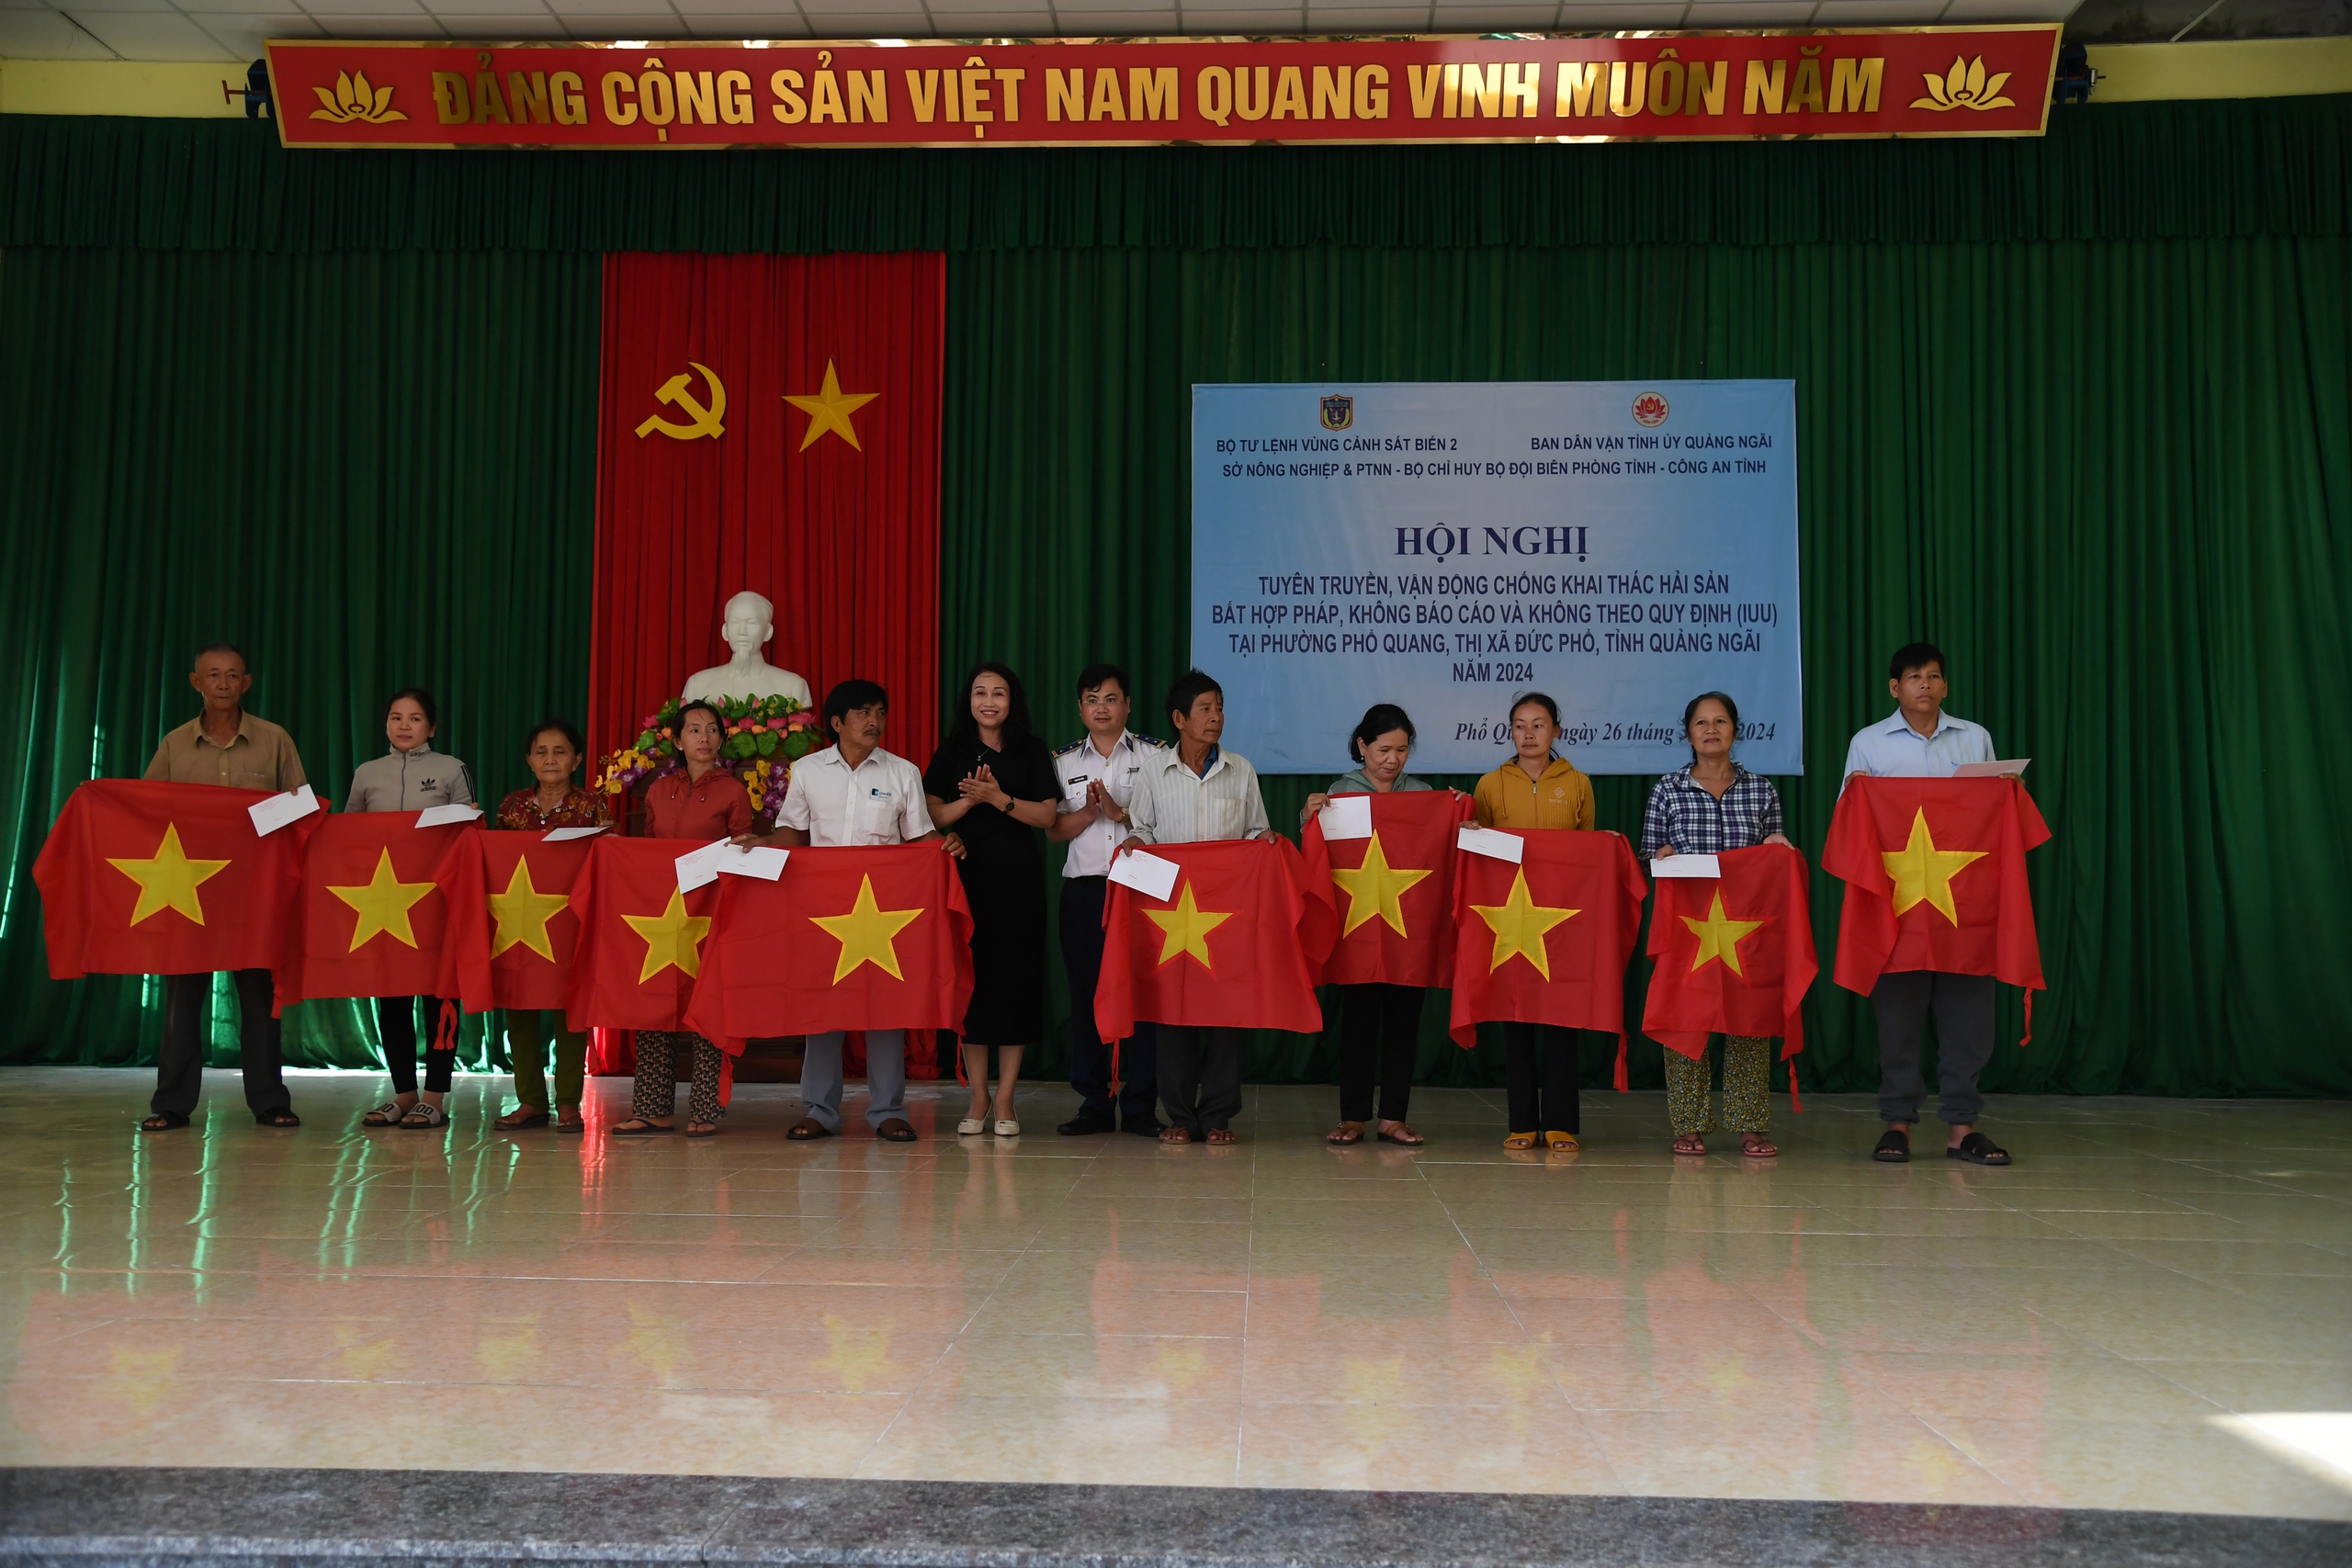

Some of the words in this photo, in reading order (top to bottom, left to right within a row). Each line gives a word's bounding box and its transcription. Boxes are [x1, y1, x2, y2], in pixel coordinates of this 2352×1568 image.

[432, 51, 588, 126] ĐẢNG
[602, 58, 753, 141] CỘNG
[771, 51, 888, 124] SẢN
[905, 57, 1025, 139] VIỆT
[1046, 67, 1179, 121] NAM
[1197, 64, 1389, 127] QUANG
[1407, 62, 1541, 119] VINH
[1555, 48, 1728, 118] MUÔN
[1742, 45, 1885, 115] NĂM
[1216, 439, 1236, 455] BỘ
[1239, 440, 1259, 452] TƯ
[1262, 438, 1297, 455] LỆNH
[1301, 436, 1339, 452] VÙNG
[1343, 436, 1381, 451] CẢNH
[1385, 436, 1411, 451] SÁT
[1415, 435, 1446, 451] BIỂN
[1450, 438, 1458, 451] 2
[1531, 437, 1559, 450] BAN
[1564, 434, 1592, 450] DÂN
[1596, 435, 1623, 453] VẬN
[1628, 434, 1658, 449] TỈNH
[1663, 434, 1680, 449] ỦY
[1685, 433, 1735, 449] QUẢNG
[1738, 434, 1771, 448] NGÃI
[1223, 461, 1243, 477] SỞ
[1247, 461, 1285, 477] NÔNG
[1289, 462, 1340, 479] NGHIỆP
[1343, 463, 1352, 476] &
[1357, 463, 1392, 476] PTNN
[1404, 462, 1424, 479] BỘ
[1428, 460, 1450, 476] CHỈ
[1454, 463, 1482, 476] HUY
[1486, 461, 1506, 479] BỘ
[1509, 461, 1532, 479] ĐỘI
[1537, 459, 1568, 475] BIÊN
[1572, 459, 1621, 475] PHÒNG
[1624, 458, 1656, 474] TỈNH
[1668, 458, 1708, 474] CÔNG
[1712, 461, 1731, 474] AN
[1735, 457, 1766, 473] TỈNH
[1394, 522, 1472, 563] HỘI
[1482, 526, 1589, 562] NGHỊ
[1259, 571, 1315, 595] TUYÊN
[1320, 571, 1393, 598] TRUYỀN,
[1397, 574, 1433, 599] VẬN
[1438, 573, 1488, 599] ĐỘNG
[1493, 571, 1556, 595] CHỐNG
[1562, 575, 1602, 594] KHAI
[1607, 570, 1654, 594] THÁC
[1659, 570, 1689, 593] HẢI
[1693, 570, 1729, 593] SẢN
[1212, 601, 1246, 625] BẤT
[1251, 604, 1288, 628] HỢP
[1293, 600, 1343, 627] PHÁP,
[1349, 600, 1411, 625] KHÔNG
[1417, 600, 1453, 624] BÁO
[1458, 600, 1495, 624] CÁO
[1499, 600, 1524, 624] VÀ
[1529, 600, 1591, 624] KHÔNG
[1597, 604, 1644, 624] THEO
[1648, 604, 1685, 624] QUY
[1690, 604, 1732, 627] ĐỊNH
[1736, 604, 1778, 627] (IUU)
[1229, 634, 1256, 658] TẠI
[1261, 628, 1337, 653] PHƯỜNG
[1342, 628, 1377, 653] PHỔ
[1383, 634, 1450, 656] QUANG,
[1454, 634, 1481, 657] THỊ
[1487, 629, 1510, 653] XÃ
[1515, 629, 1554, 652] ĐỨC
[1559, 628, 1600, 656] PHỔ,
[1604, 629, 1645, 653] TỈNH
[1649, 628, 1713, 653] QUẢNG
[1718, 629, 1760, 652] NGÃI
[1453, 659, 1490, 682] NĂM
[1496, 662, 1533, 682] 2024
[1453, 716, 1487, 740] Phổ
[1601, 722, 1623, 741] 26
[1626, 722, 1675, 746] tháng
[1736, 722, 1776, 741] 2024
